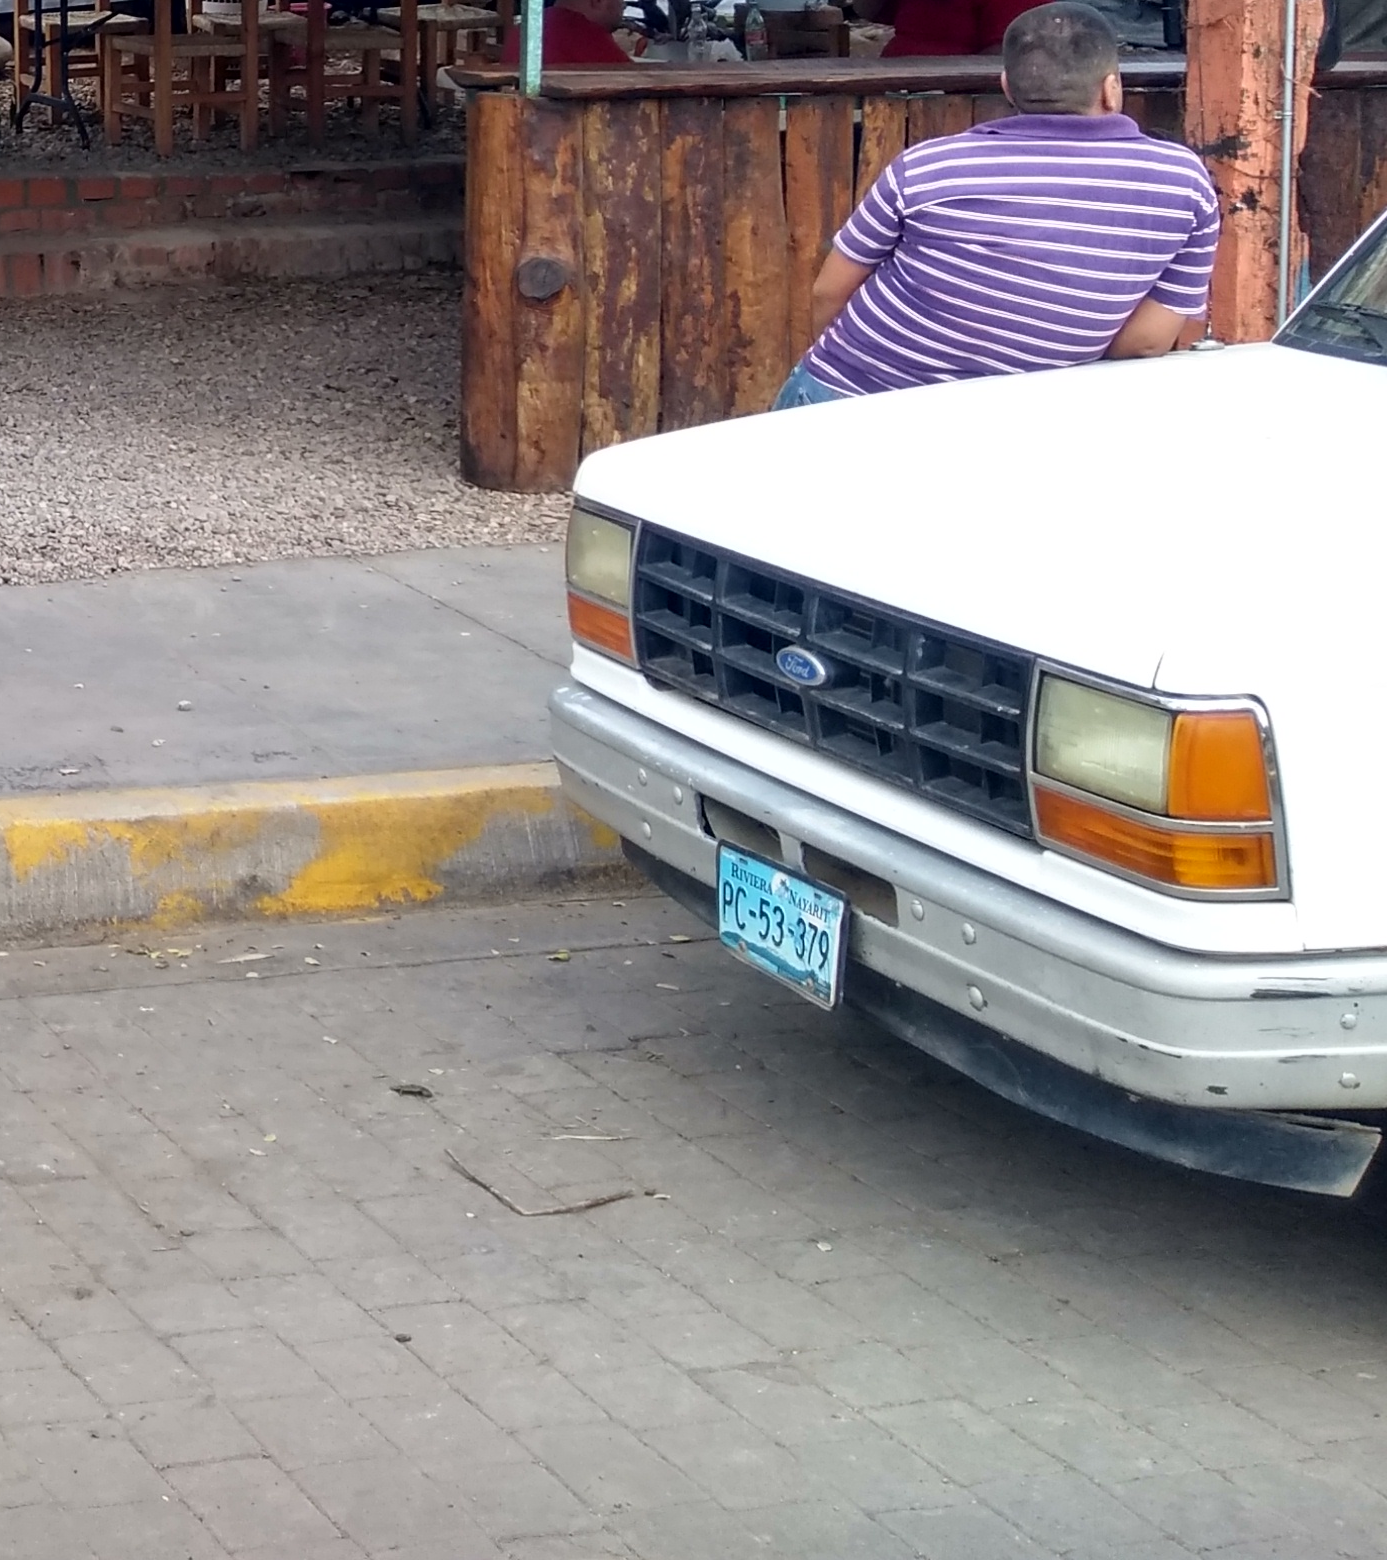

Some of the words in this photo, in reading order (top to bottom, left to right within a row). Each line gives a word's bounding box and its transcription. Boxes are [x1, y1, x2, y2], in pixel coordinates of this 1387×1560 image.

[784, 653, 811, 678] Ford
[730, 862, 773, 896] RIVIERA
[788, 888, 832, 923] NAYARIT
[723, 880, 829, 971] PC-53-379
